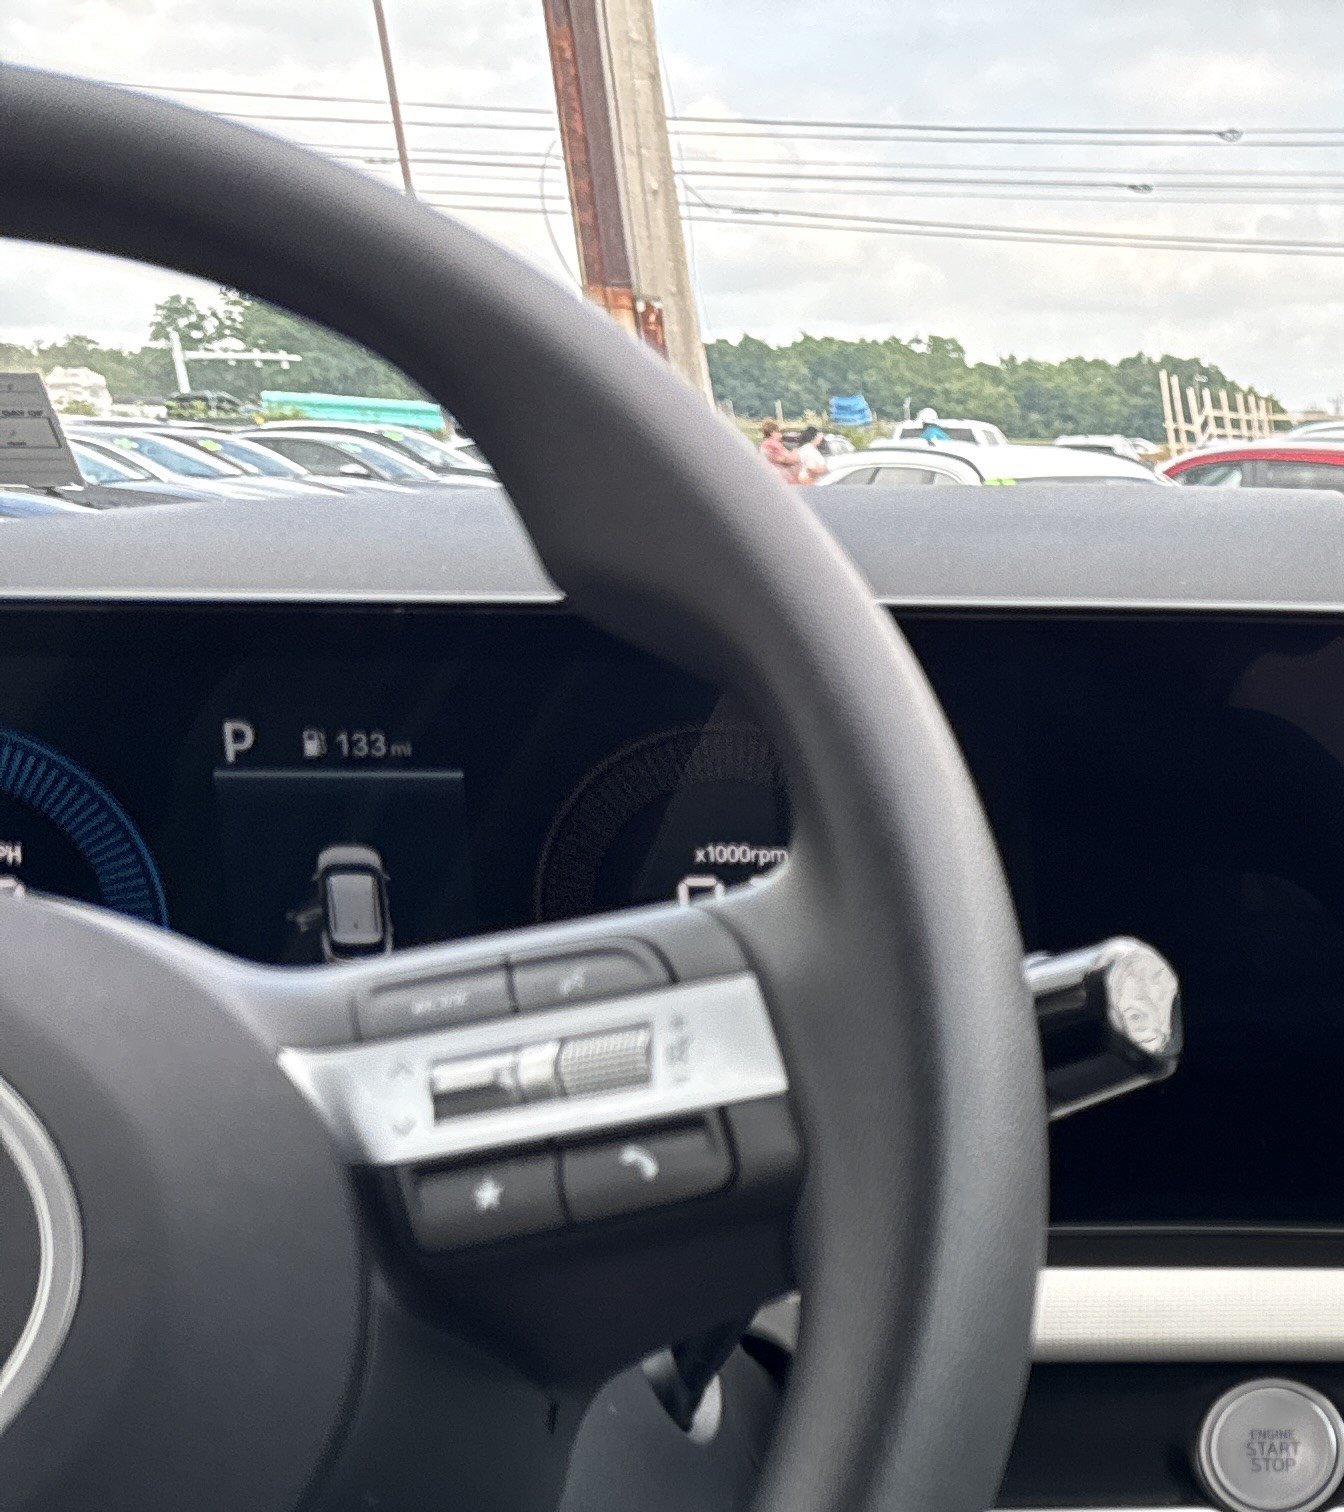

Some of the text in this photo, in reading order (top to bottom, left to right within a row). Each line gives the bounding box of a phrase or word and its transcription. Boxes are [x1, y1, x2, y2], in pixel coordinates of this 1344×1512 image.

[222, 719, 255, 764] P
[336, 730, 388, 758] 133
[694, 844, 789, 866] x1000rpm
[1246, 1441, 1302, 1457] START
[1250, 1458, 1297, 1473] STOP
